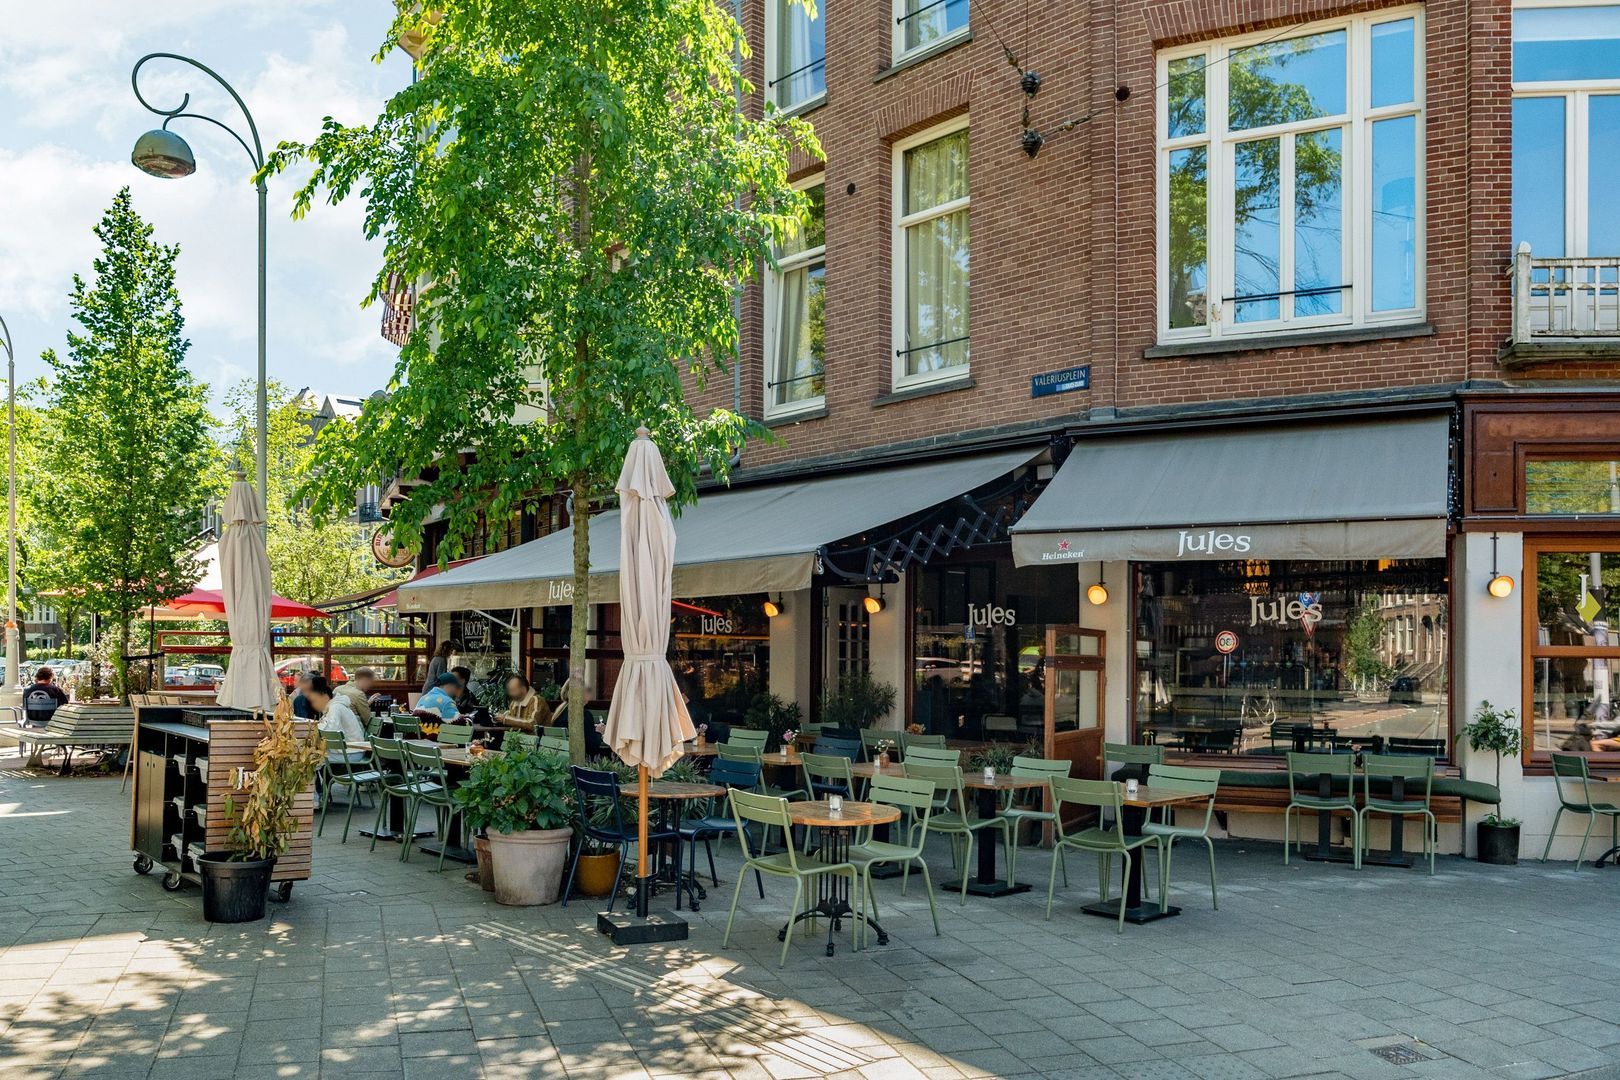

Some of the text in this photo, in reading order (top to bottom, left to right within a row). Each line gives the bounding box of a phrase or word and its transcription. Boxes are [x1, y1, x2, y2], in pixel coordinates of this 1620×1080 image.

[1035, 369, 1086, 386] VALERIUSPLEIN
[1042, 550, 1084, 560] Heineken
[1177, 530, 1251, 557] Jules
[968, 602, 1016, 632] Jules
[1249, 596, 1323, 627] Jules
[701, 614, 733, 636] Jules
